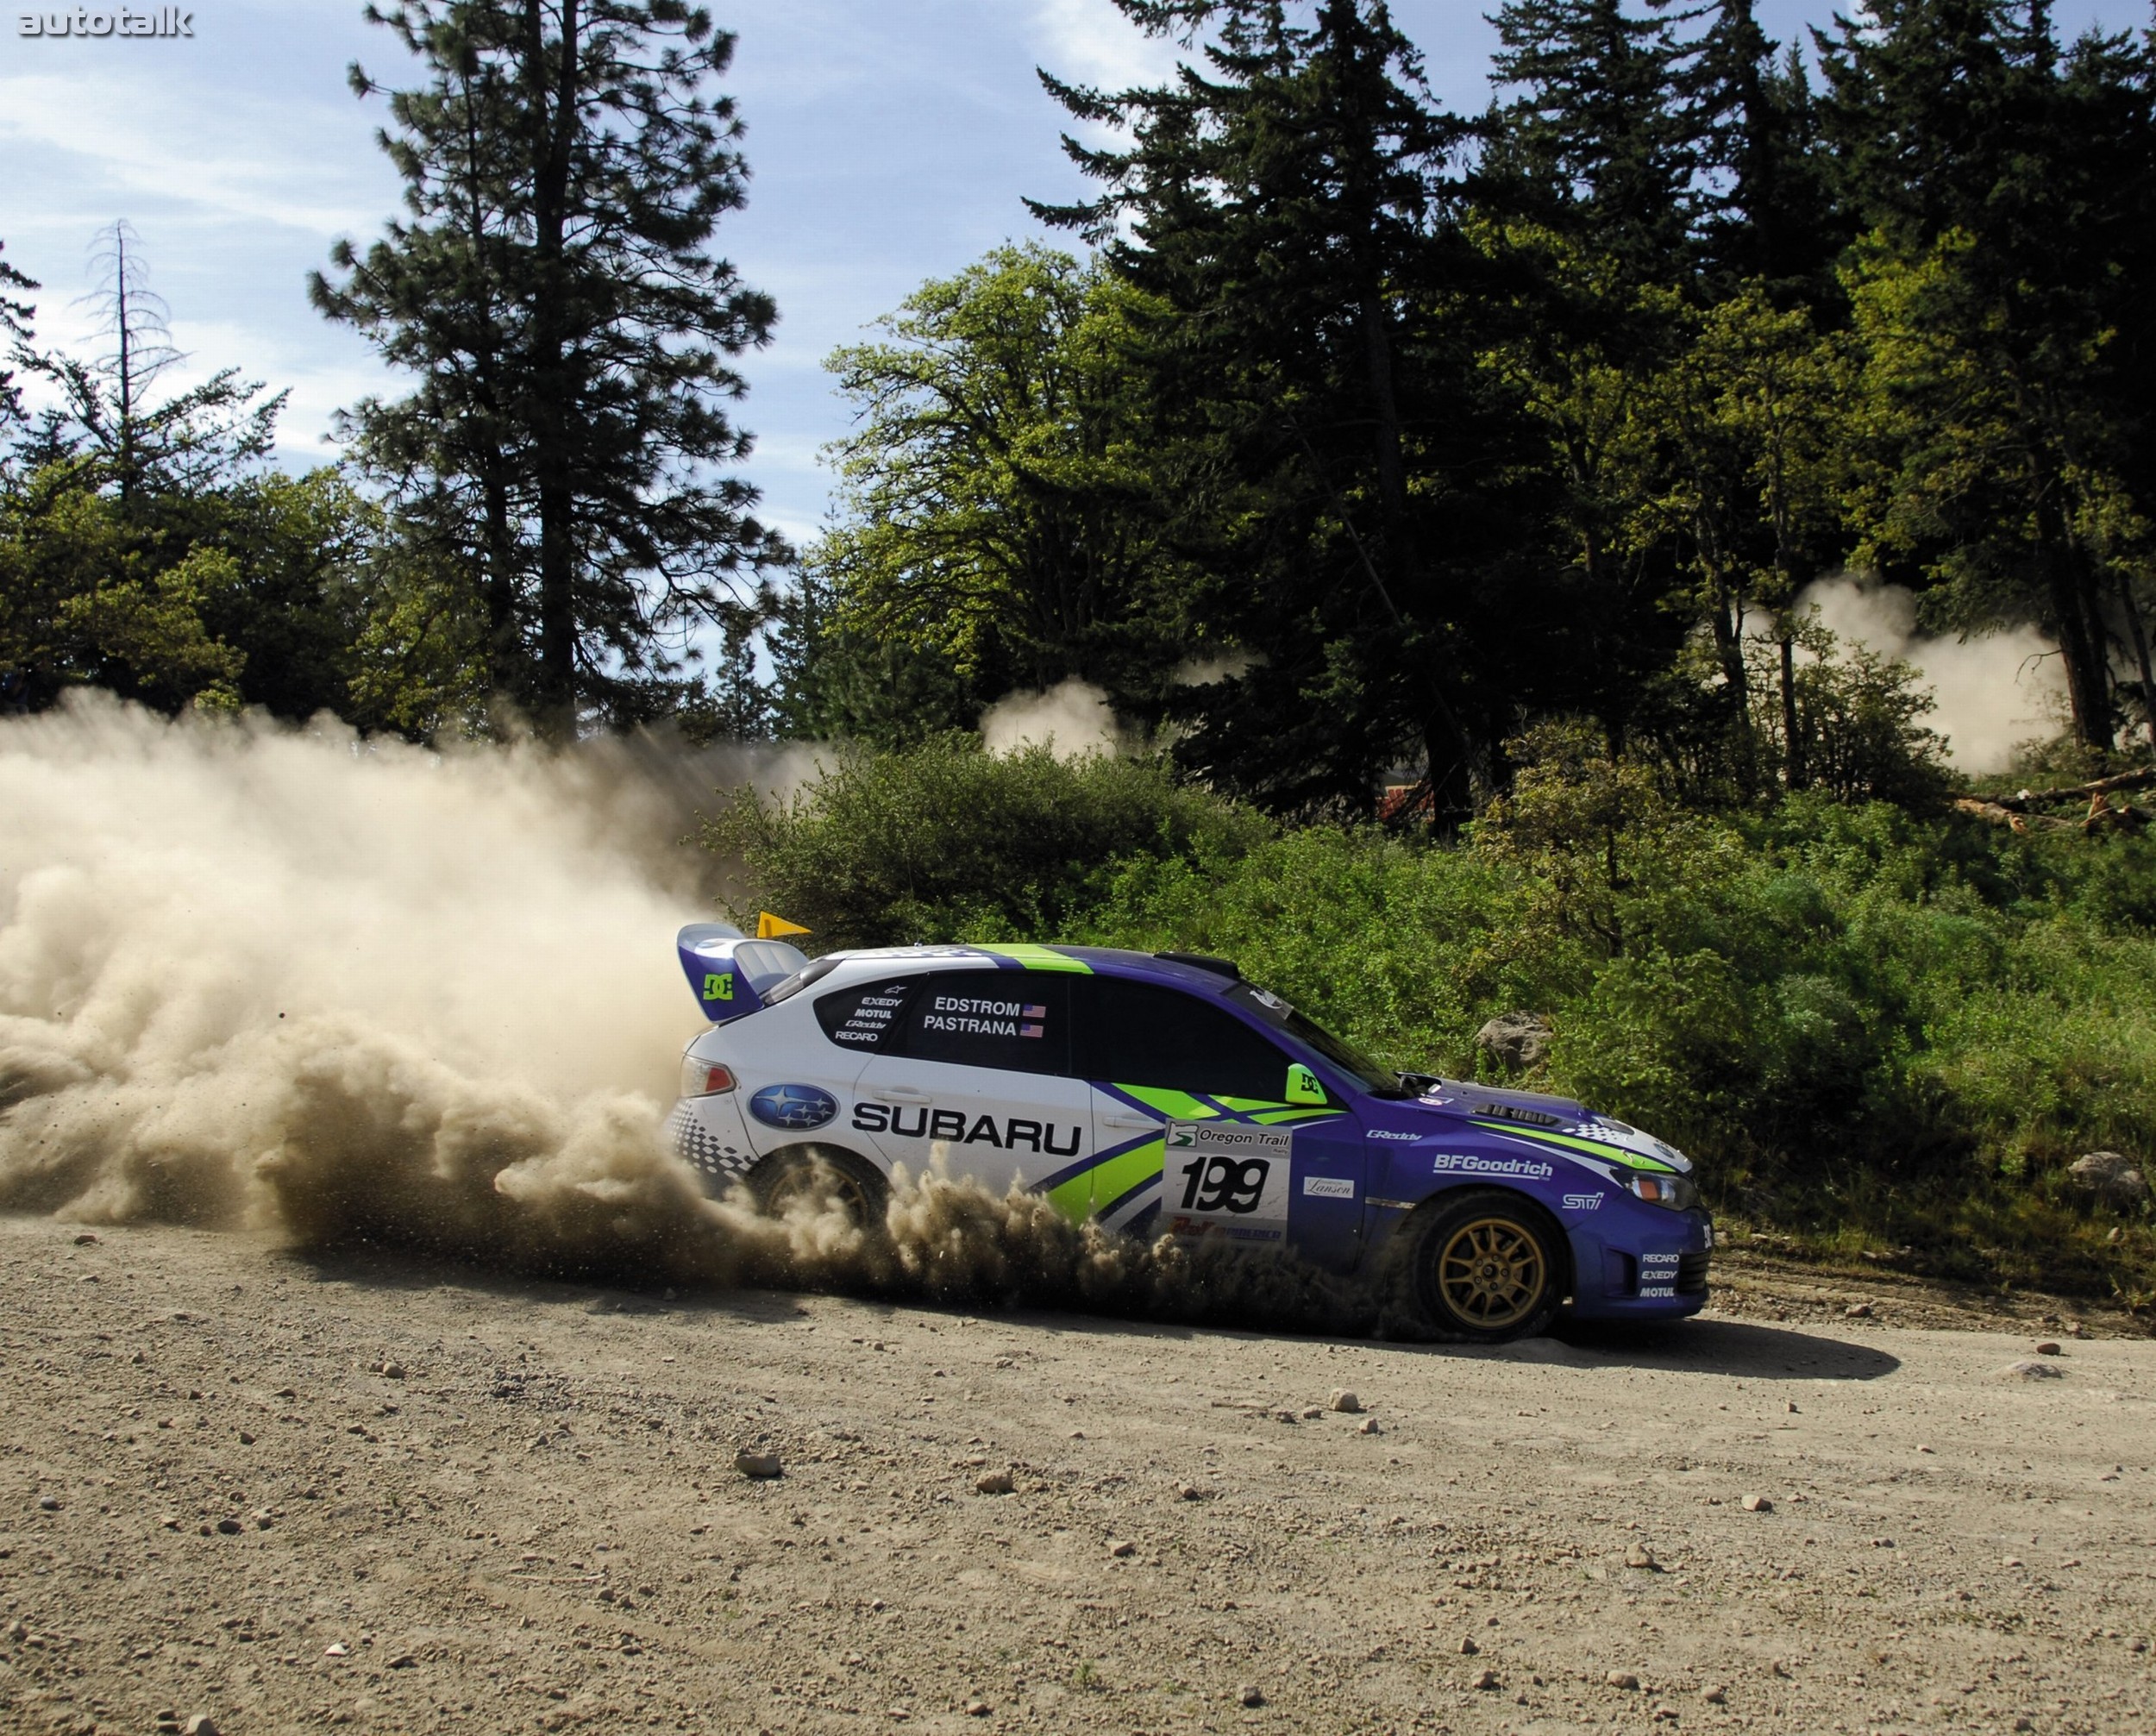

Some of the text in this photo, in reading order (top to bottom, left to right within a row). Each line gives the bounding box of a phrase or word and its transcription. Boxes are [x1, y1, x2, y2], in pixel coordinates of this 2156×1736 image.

[861, 997, 903, 1007] EXEDY
[934, 997, 1020, 1018] EDSTROM
[854, 1008, 893, 1018] MOTUL
[924, 1015, 1017, 1037] PASTRANA
[835, 1031, 878, 1042] RECARO
[851, 1101, 1081, 1157] SUBARU
[1200, 1129, 1289, 1147] Oregon Trail
[1433, 1154, 1553, 1177] BFGoodrich
[1181, 1156, 1271, 1214] 199
[1642, 1254, 1680, 1263] RECARO
[1641, 1270, 1677, 1280] EXEDY
[1639, 1288, 1675, 1297] MOTUL
